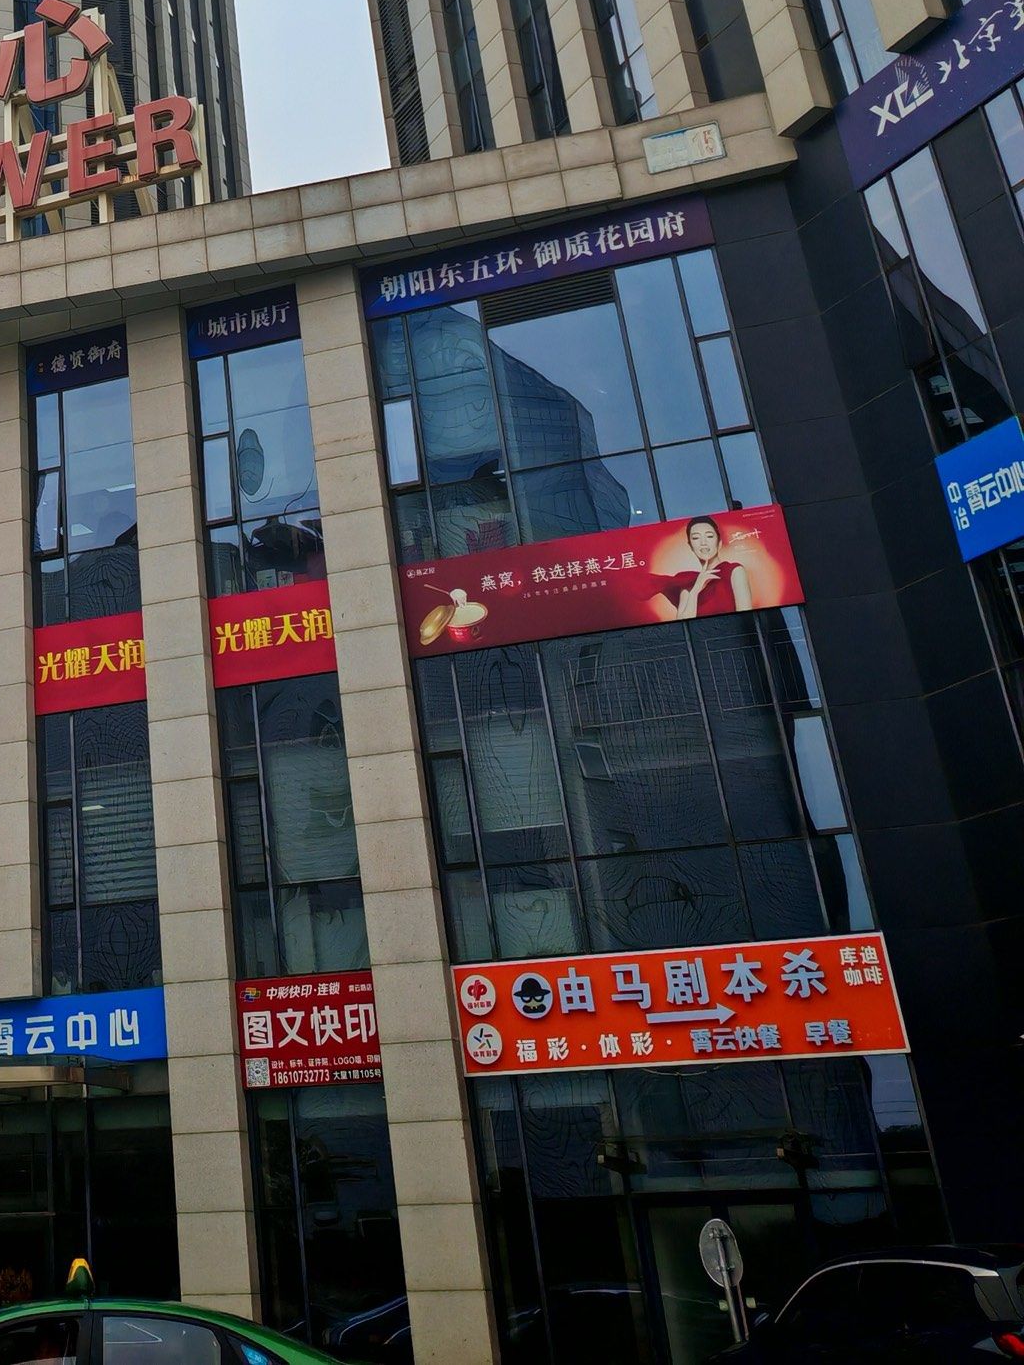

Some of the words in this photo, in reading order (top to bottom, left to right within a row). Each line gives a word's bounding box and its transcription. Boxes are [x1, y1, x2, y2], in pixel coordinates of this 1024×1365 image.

[380, 248, 525, 302] 朝阳东五环
[533, 211, 686, 269] 御质花园府
[208, 301, 290, 338] 城市展厅
[50, 340, 123, 374] 德贤御府
[215, 608, 335, 655] 光耀天润
[38, 639, 144, 684] 光耀天润
[839, 945, 879, 966] 库迪
[556, 948, 828, 1015] 由马剧本杀
[843, 966, 884, 986] 咖啡
[242, 1003, 376, 1050] 图文快印
[803, 1019, 854, 1047] 早餐
[273, 1069, 330, 1084] 18610732773
